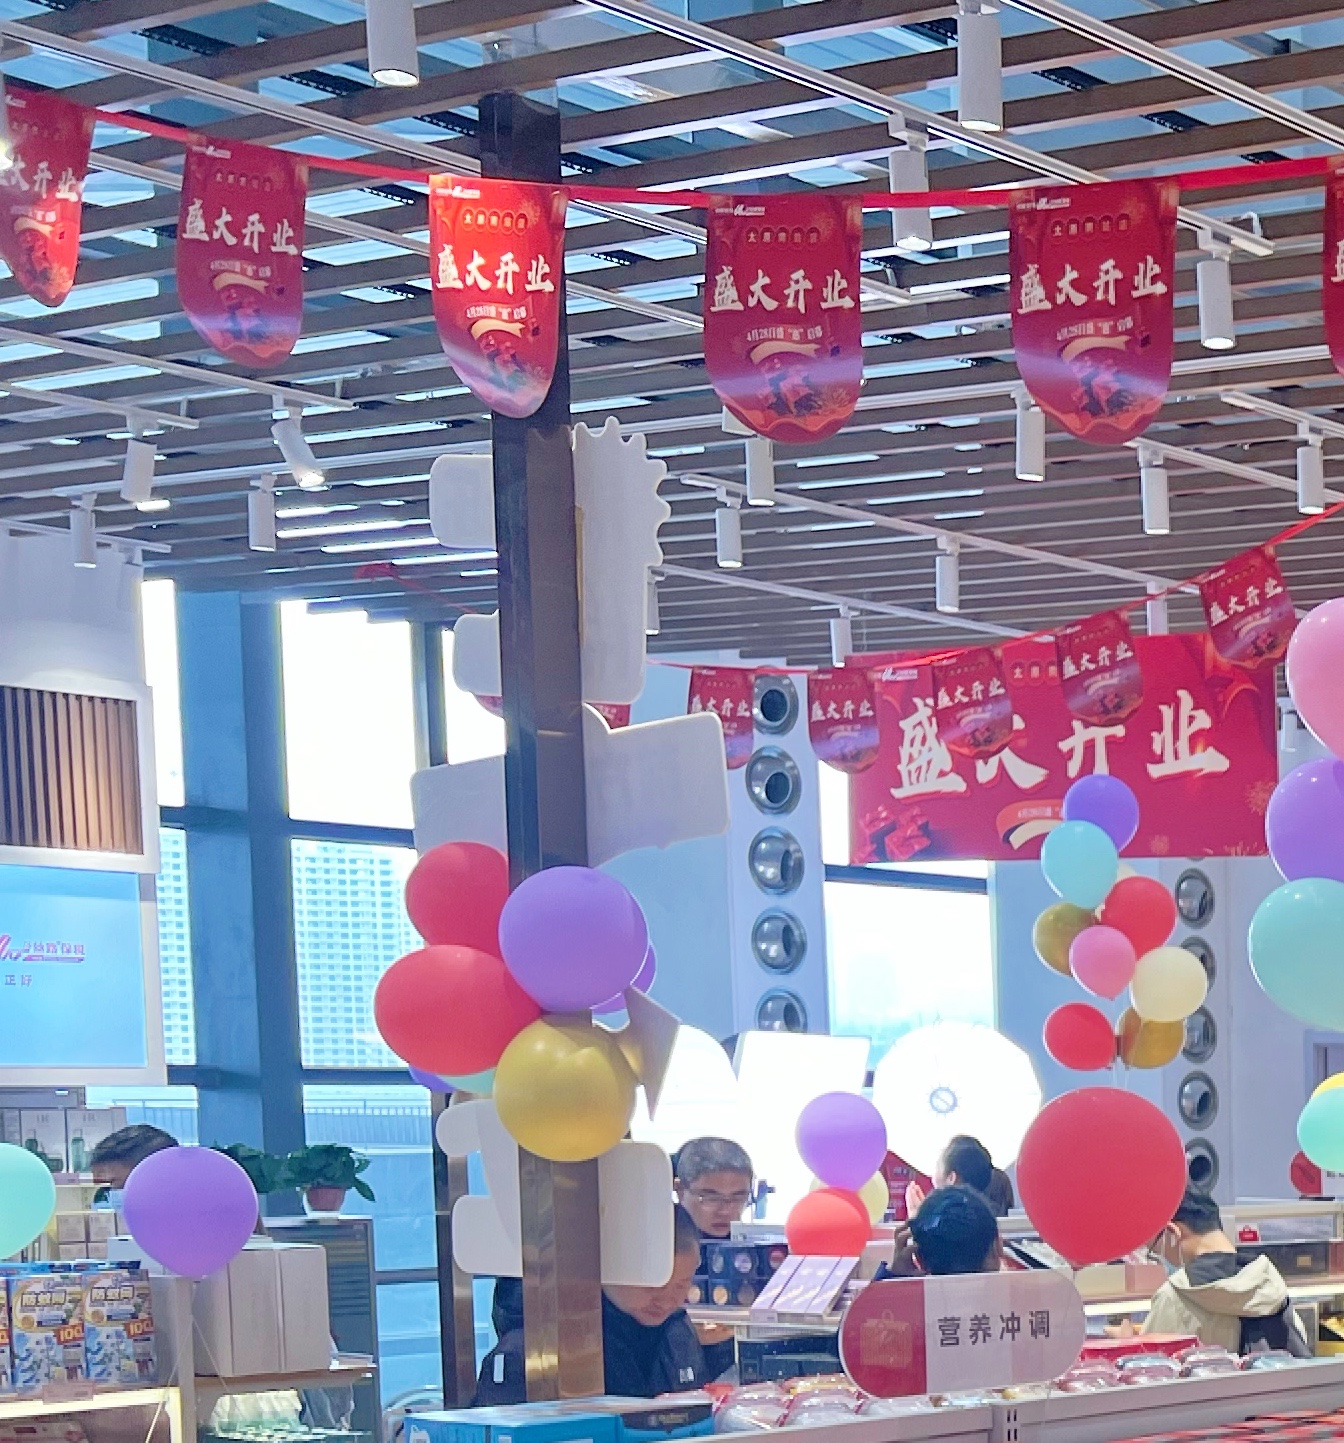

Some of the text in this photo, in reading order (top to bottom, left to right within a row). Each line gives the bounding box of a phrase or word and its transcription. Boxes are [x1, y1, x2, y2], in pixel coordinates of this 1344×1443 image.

[0, 153, 79, 202] 大开业
[182, 198, 299, 256] 盛大开业
[436, 243, 554, 294] 盛大开业
[710, 266, 855, 314] 盛大开业
[1017, 254, 1168, 314] 盛大开业
[1210, 577, 1283, 627] 盛大开业
[1062, 641, 1133, 680] 盛大开业
[691, 694, 751, 719] 盛大开业
[810, 697, 874, 723] 盛大开业
[936, 676, 1006, 710] 盛大开业
[937, 1308, 1052, 1348] 营养冲调
